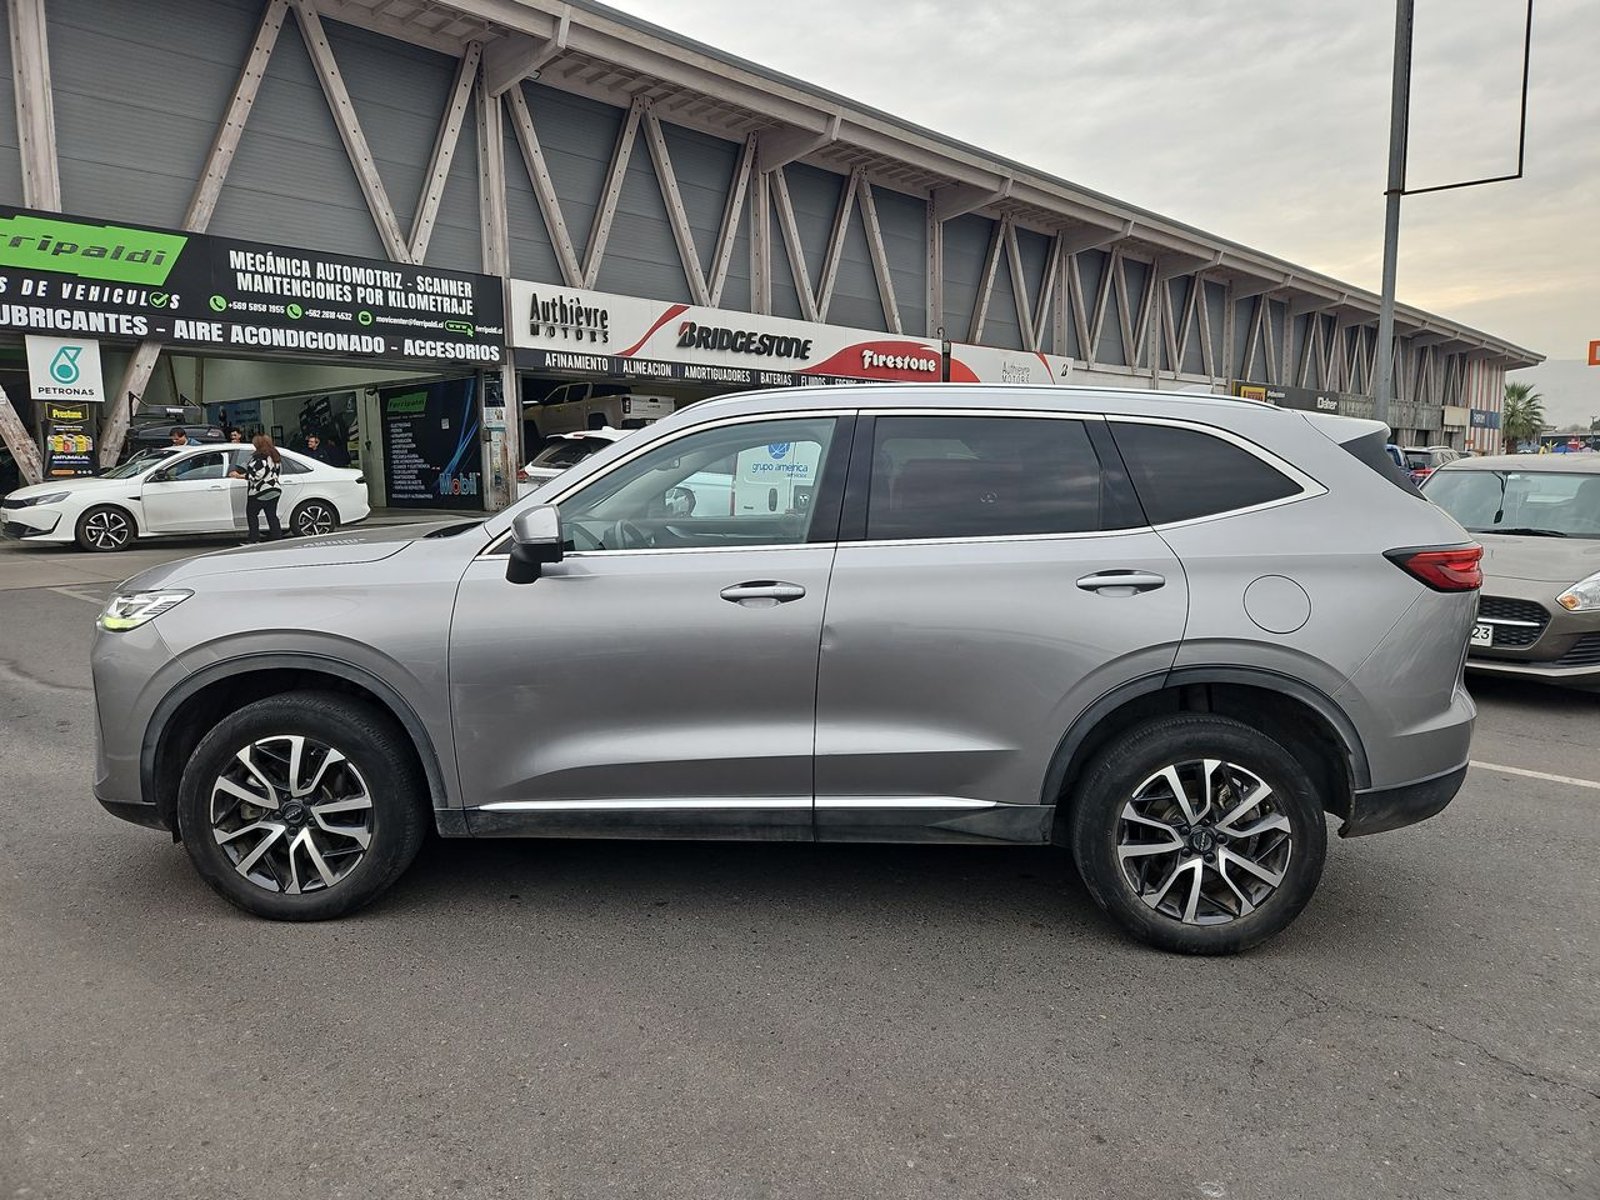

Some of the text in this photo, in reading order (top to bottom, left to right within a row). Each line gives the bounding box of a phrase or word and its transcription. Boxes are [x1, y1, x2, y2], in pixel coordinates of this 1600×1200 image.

[0, 233, 167, 266] ripaldi
[21, 279, 48, 297] DE
[229, 250, 311, 278] MECÁNICA
[316, 262, 403, 289] AUTOMOTRIZ
[416, 275, 472, 298] SCANNER
[236, 272, 474, 316] MANTENCIONES POR KILOMETRAJE
[530, 292, 609, 329] Authièvre
[174, 319, 224, 342] AIRE
[230, 325, 385, 353] ACONDICIONADO
[403, 339, 500, 361] ACCESORIOS
[530, 323, 610, 344] MOTORS
[676, 320, 813, 360] BRIDGESTONE
[545, 353, 609, 371] AFINAMIENTO
[623, 361, 672, 377] ALINEACION
[684, 366, 750, 383] AMORTIGUADORES
[760, 372, 792, 386] BATERIAS
[861, 349, 936, 372] Firestone
[38, 386, 95, 396] PETRONAS
[752, 463, 775, 473] grupo
